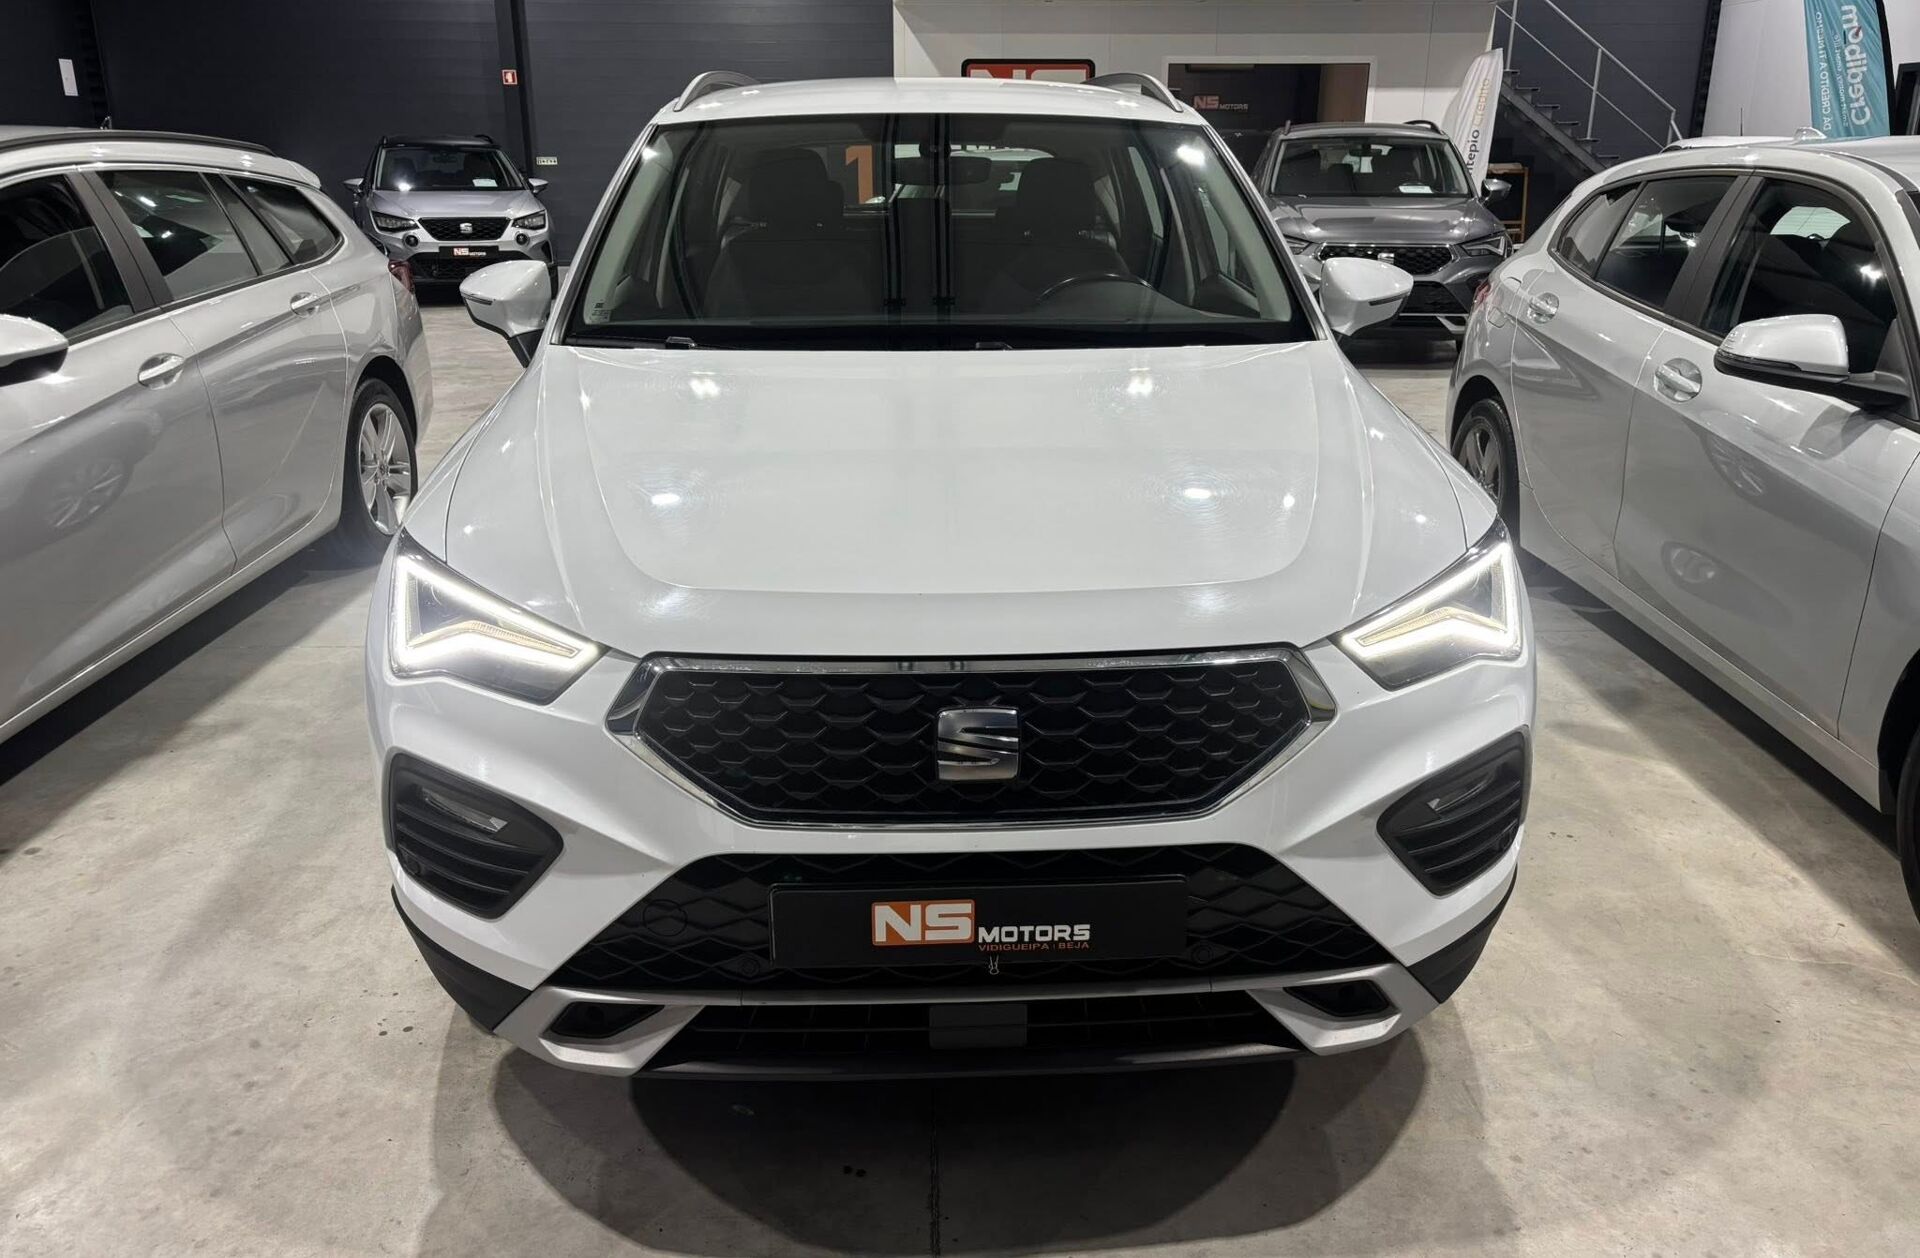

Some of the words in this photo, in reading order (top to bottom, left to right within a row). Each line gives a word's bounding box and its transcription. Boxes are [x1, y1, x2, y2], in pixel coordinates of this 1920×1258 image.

[1194, 96, 1219, 109] NS
[453, 247, 469, 256] NS
[874, 903, 972, 942] NS
[978, 924, 1091, 943] MOTORS
[1058, 941, 1090, 950] BEJA
